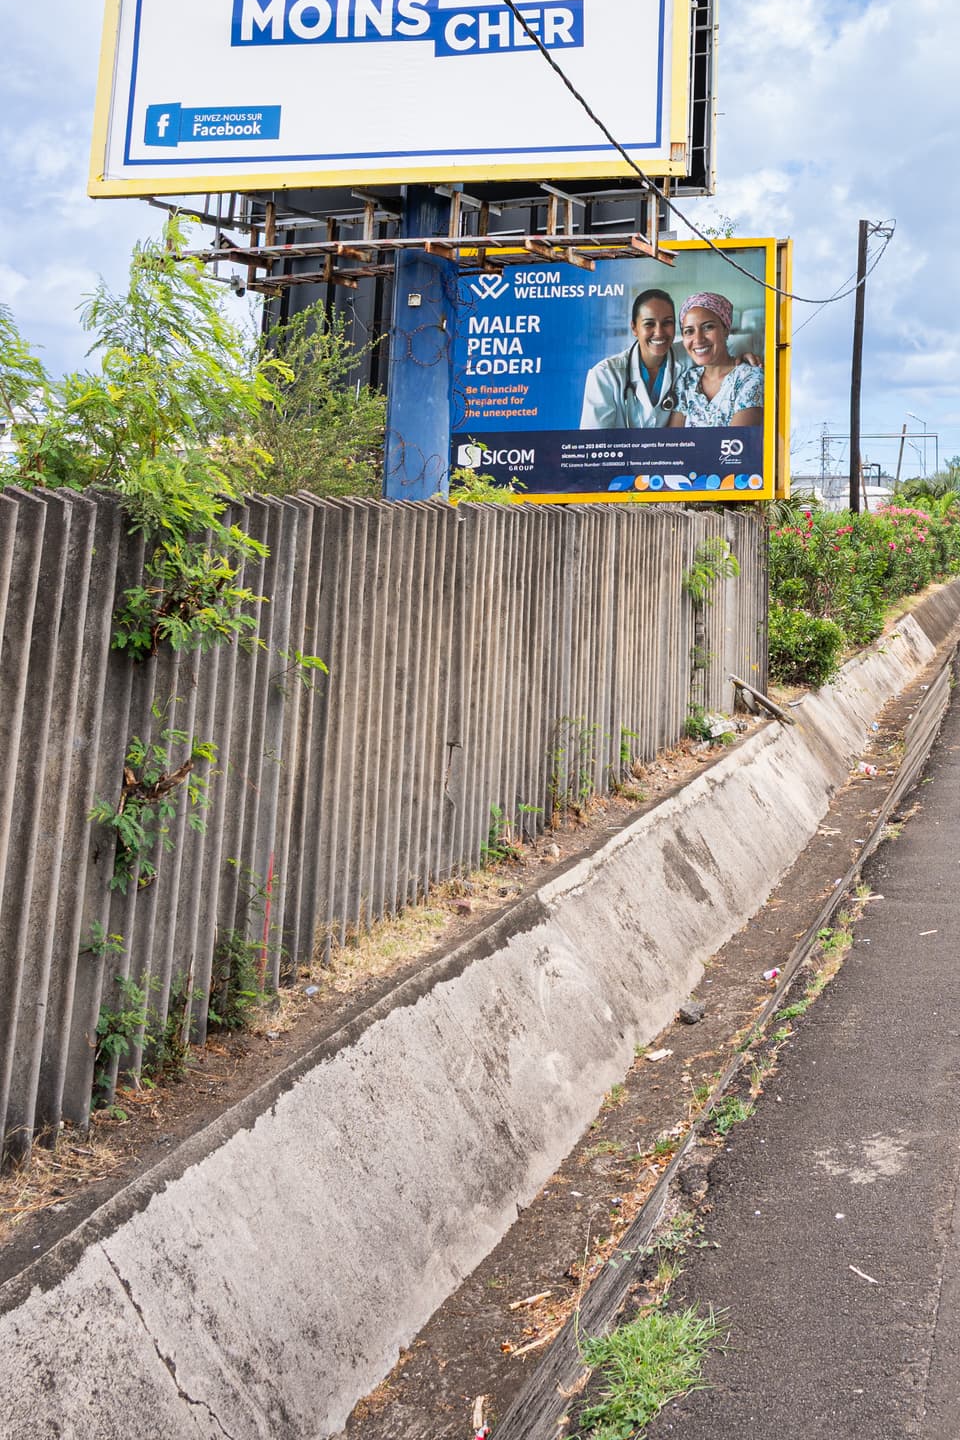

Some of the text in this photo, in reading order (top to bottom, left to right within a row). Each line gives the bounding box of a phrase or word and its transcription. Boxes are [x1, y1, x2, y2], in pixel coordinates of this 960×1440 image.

[444, 7, 576, 51] CHER
[193, 113, 263, 122] SUIVEZ-NOUS SUR
[192, 122, 262, 137] Facebook
[514, 271, 561, 285] SICOM
[514, 284, 624, 300] WELLNESS PLAN
[468, 315, 541, 335] MALER
[467, 337, 523, 356] PENA
[465, 383, 529, 395] Be financially
[510, 395, 525, 405] for
[483, 407, 538, 420] unexpected
[720, 438, 744, 456] 50
[482, 448, 535, 465] SICOM
